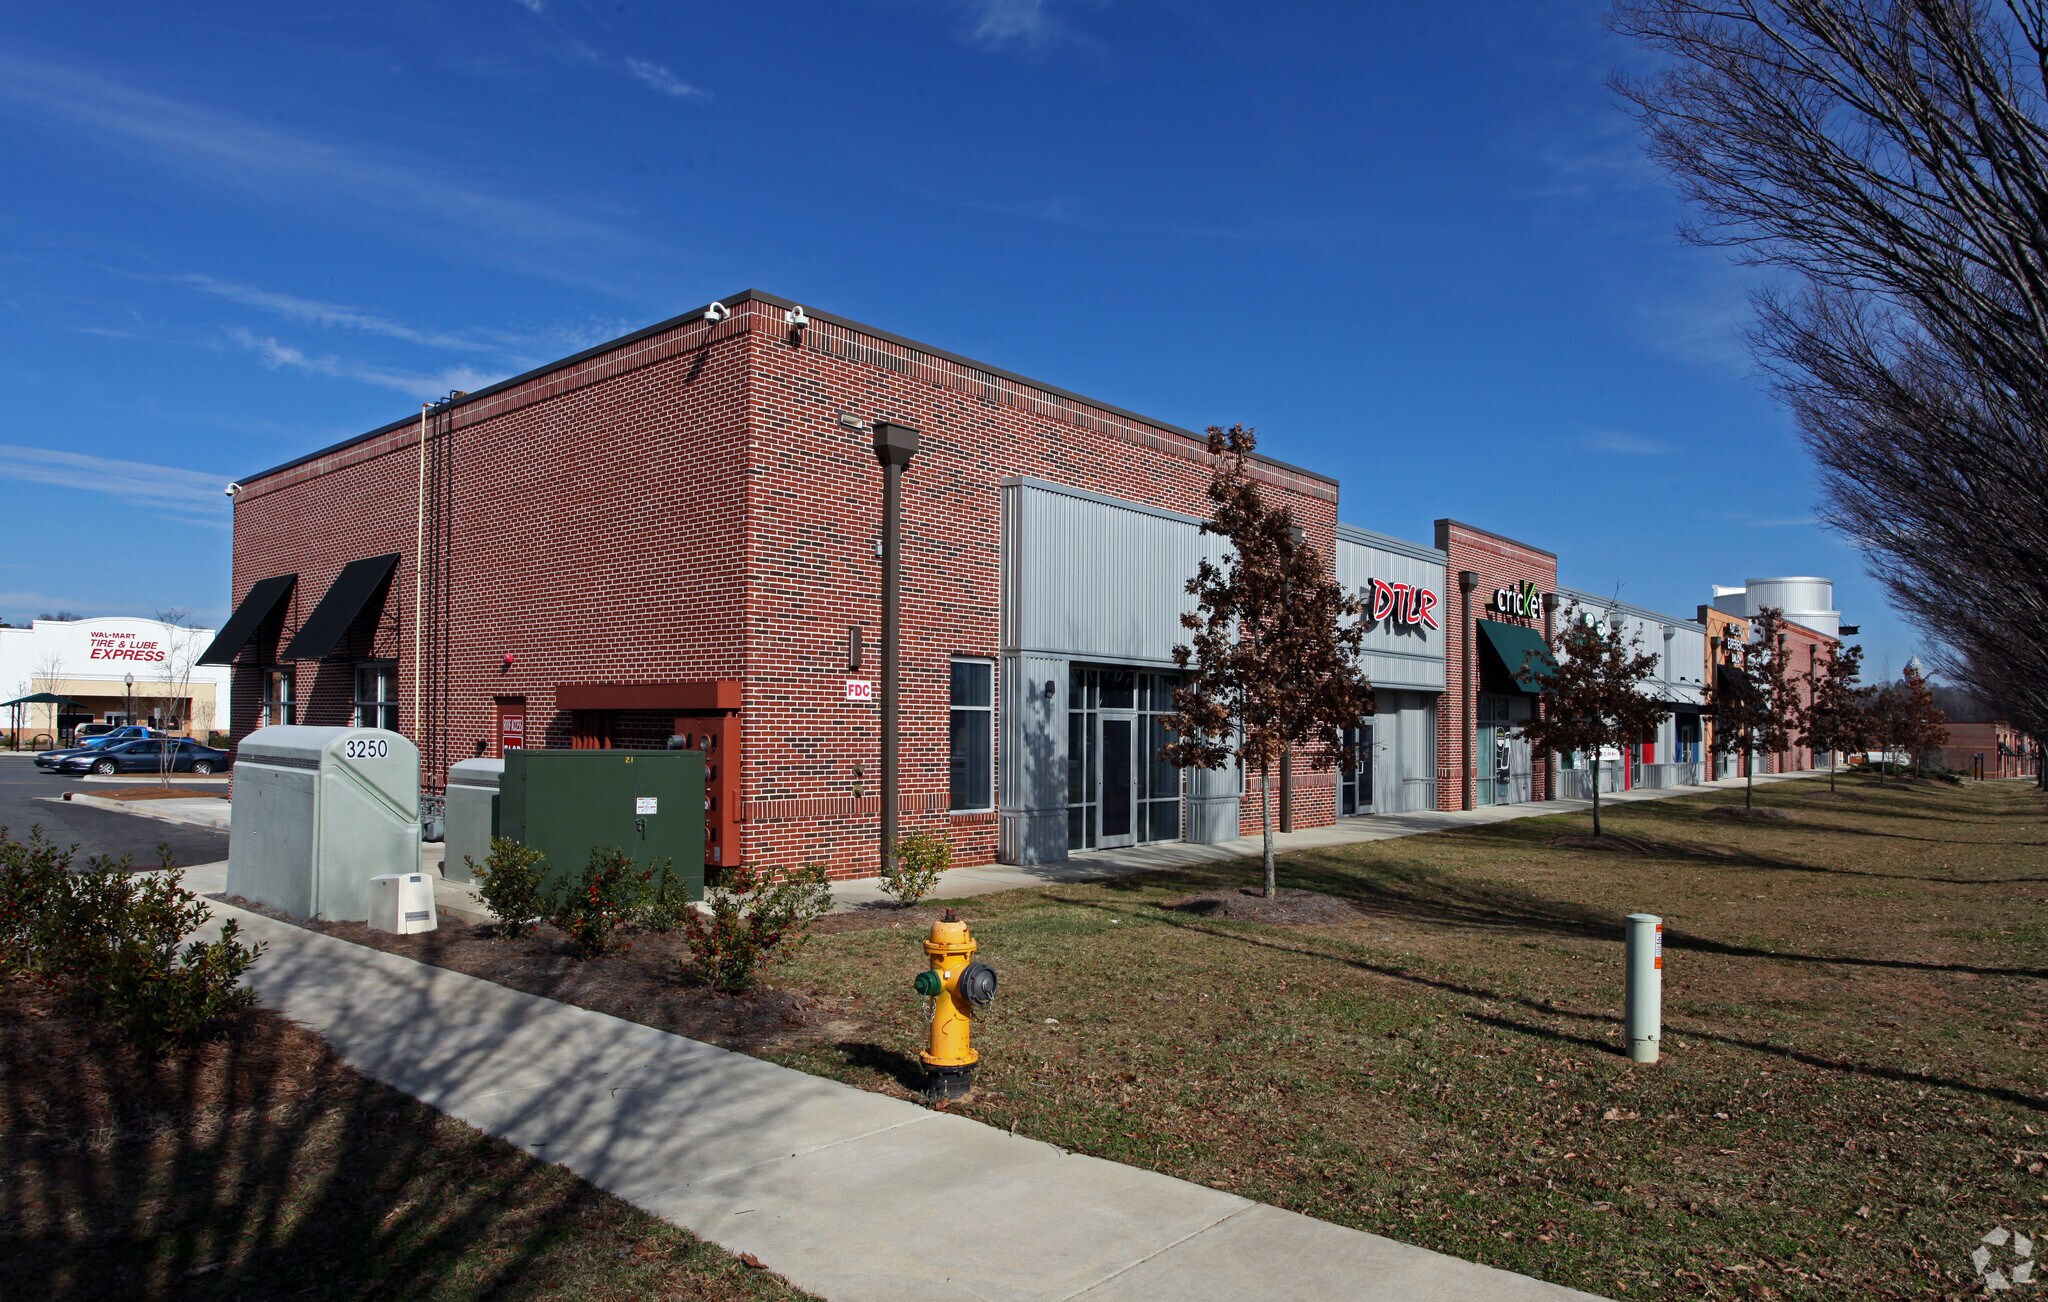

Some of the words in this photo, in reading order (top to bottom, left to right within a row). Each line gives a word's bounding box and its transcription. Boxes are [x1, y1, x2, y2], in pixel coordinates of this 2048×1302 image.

[1373, 578, 1439, 630] DTLR
[91, 639, 115, 648] TIRE
[118, 640, 126, 648] &
[129, 641, 159, 650] LUBE
[90, 648, 165, 662] EXPRESS
[848, 684, 870, 697] FDC
[346, 740, 388, 758] 3250
